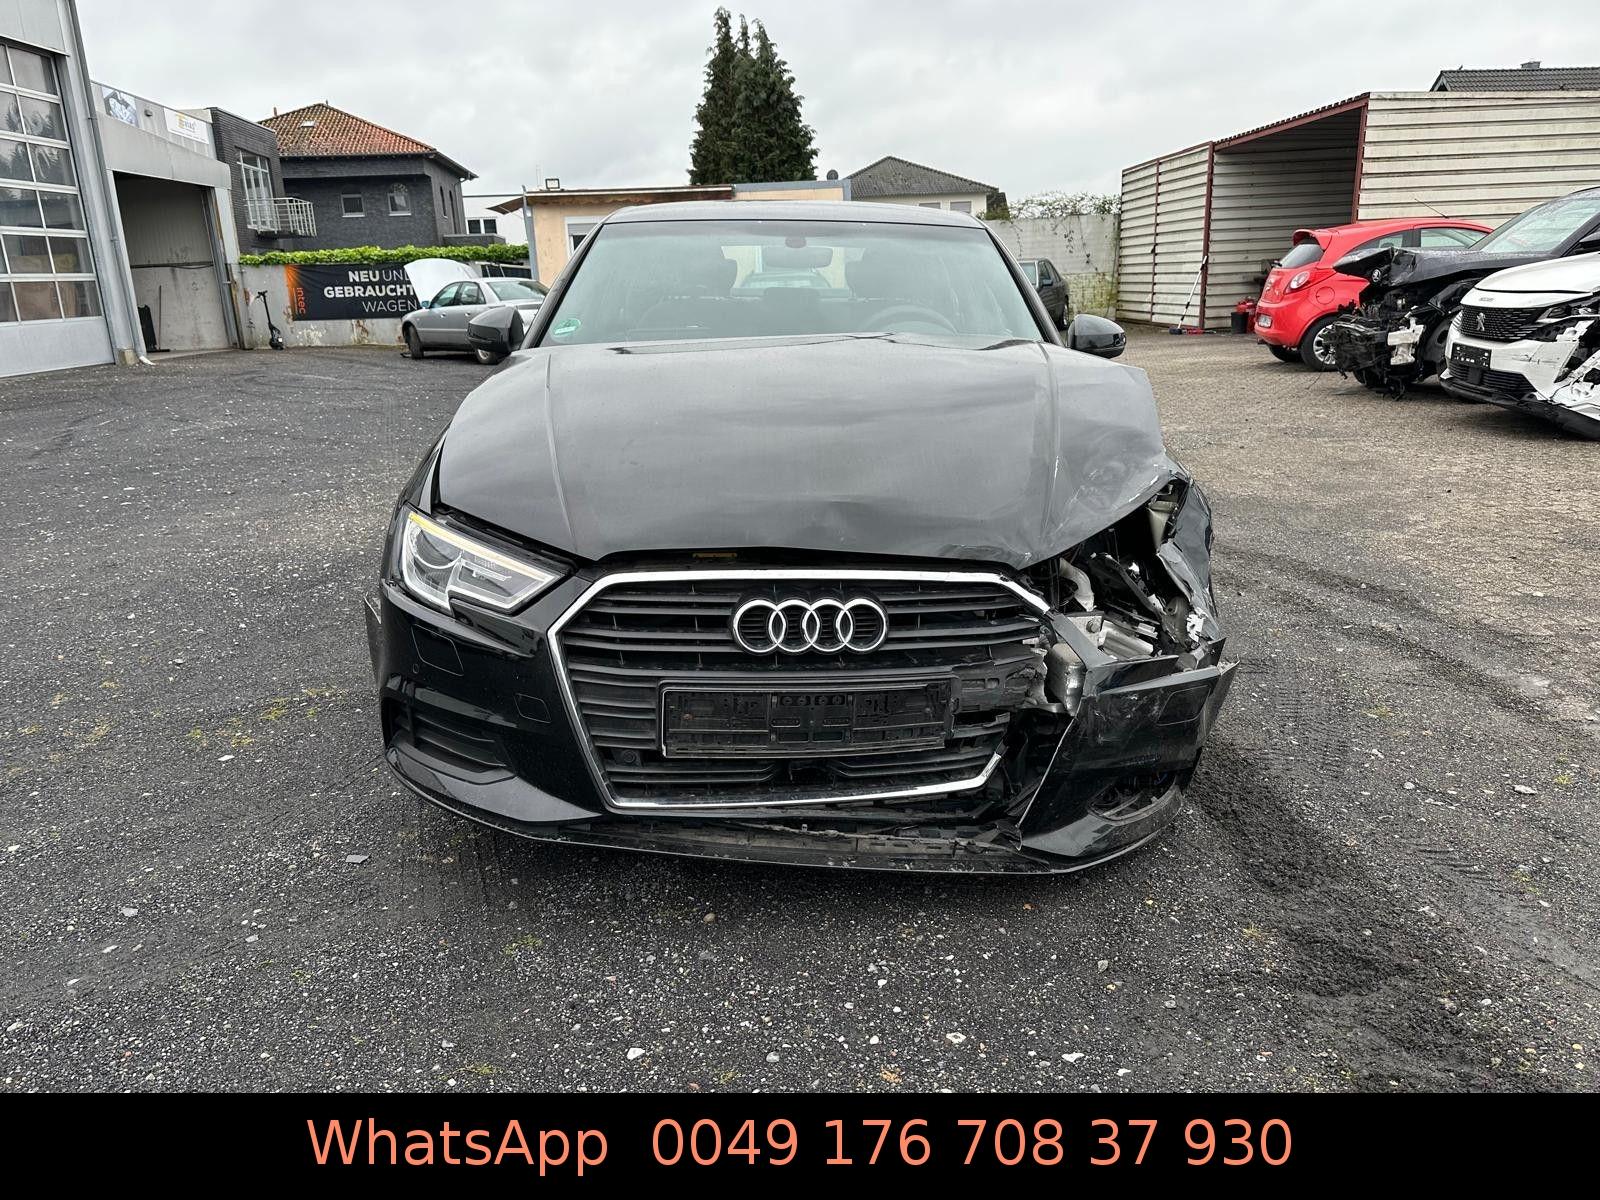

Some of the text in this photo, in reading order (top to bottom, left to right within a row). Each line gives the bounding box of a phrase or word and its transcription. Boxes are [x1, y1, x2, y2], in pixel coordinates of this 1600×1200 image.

[348, 270, 380, 283] NEU
[323, 285, 414, 298] GEBRAUCHT
[362, 300, 417, 312] WAGEN
